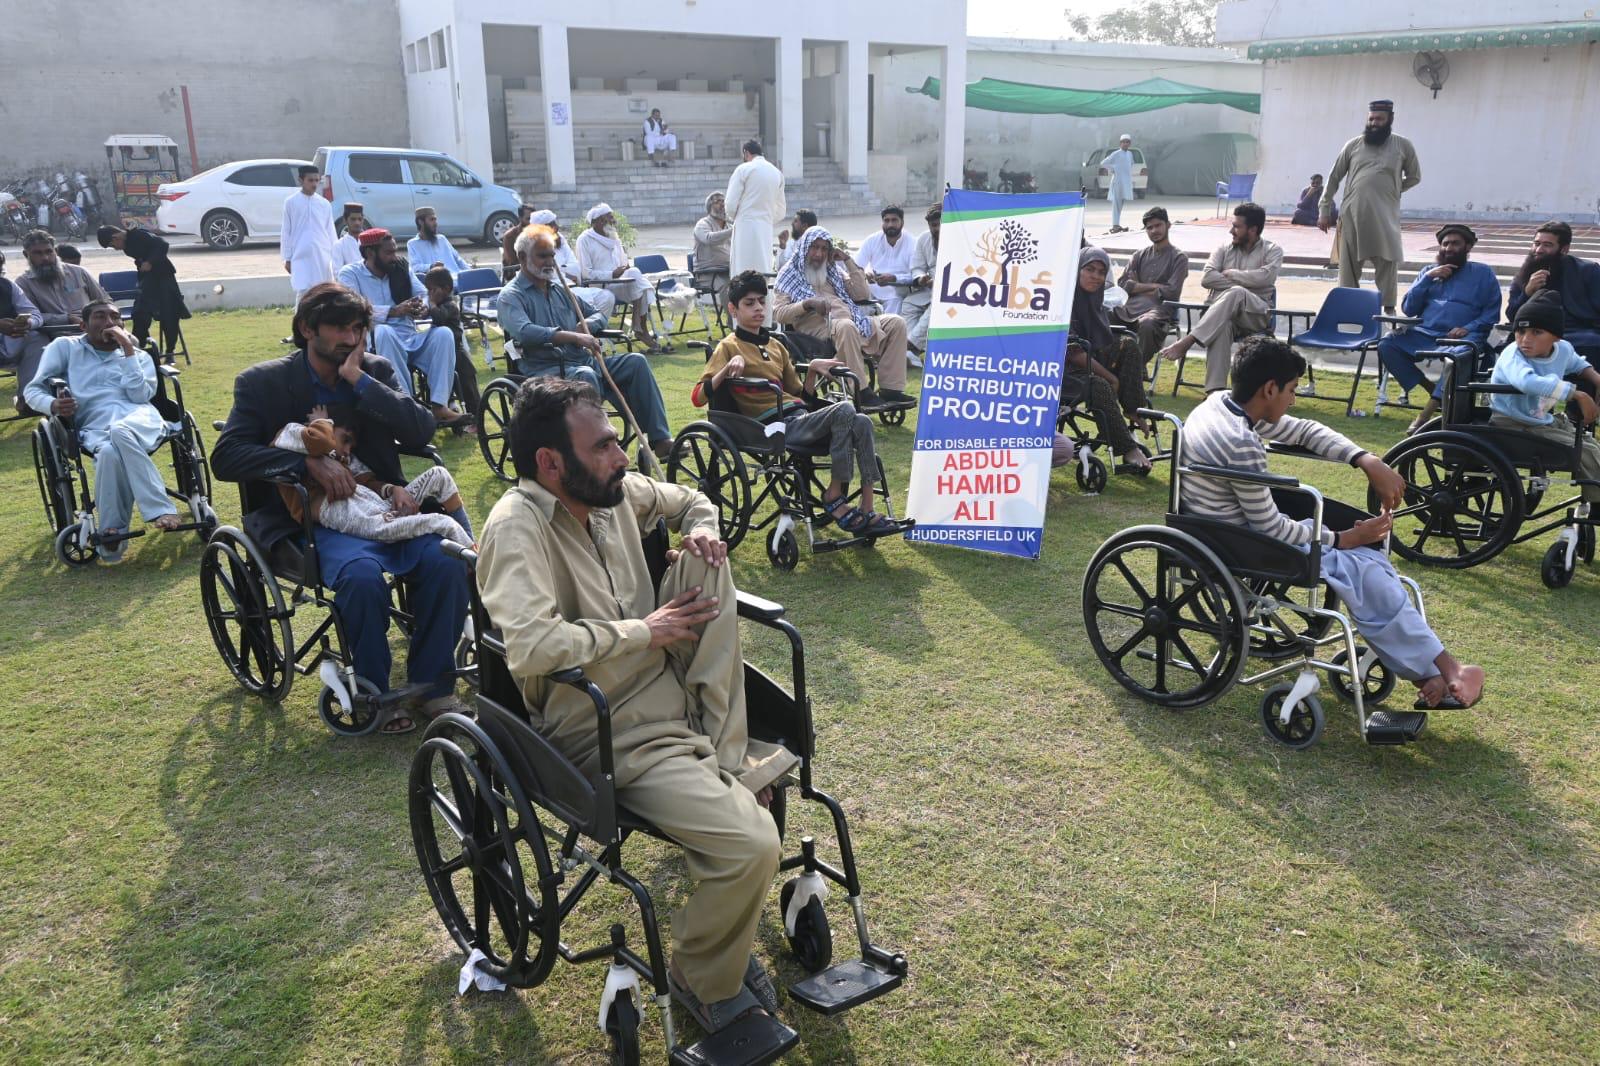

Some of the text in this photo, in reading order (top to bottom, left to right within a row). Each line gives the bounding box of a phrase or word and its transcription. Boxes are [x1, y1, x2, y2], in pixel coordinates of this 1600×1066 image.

[1003, 310, 1048, 320] Foundation
[931, 351, 1060, 378] WHEELCHAIR
[924, 374, 1060, 401] DISTRIBUTION
[927, 396, 1048, 427] PROJECT
[917, 437, 1052, 450] FOR DISABLE PERSON
[943, 449, 1018, 471] ABDUL
[937, 473, 1021, 495] HAMID
[953, 500, 995, 521] ALI
[911, 529, 1036, 542] HUDDERSFIELD UK
